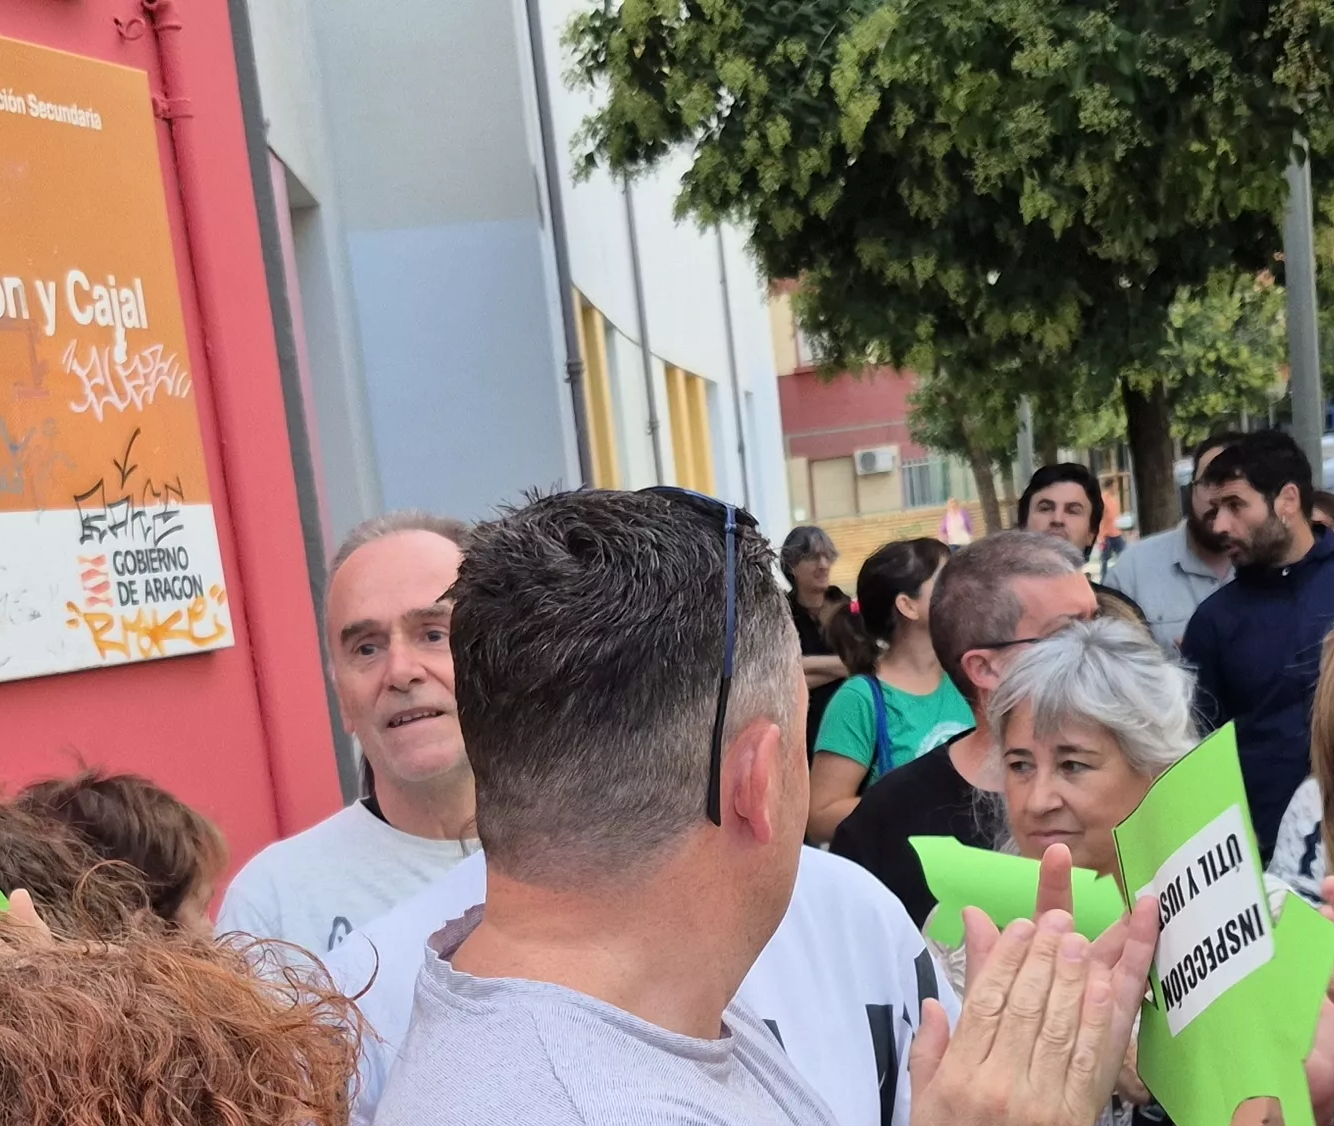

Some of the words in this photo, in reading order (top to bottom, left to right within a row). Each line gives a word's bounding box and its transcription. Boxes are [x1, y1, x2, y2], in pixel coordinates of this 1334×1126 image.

[27, 93, 103, 131] Secundaria
[35, 279, 56, 336] y
[66, 269, 148, 360] Cajal
[112, 545, 189, 577] GOBIERNO
[118, 580, 140, 607] DE
[1197, 833, 1243, 887] ÚTIL
[1186, 866, 1200, 901] Y
[1161, 903, 1265, 1013] INSPECCIÓN
